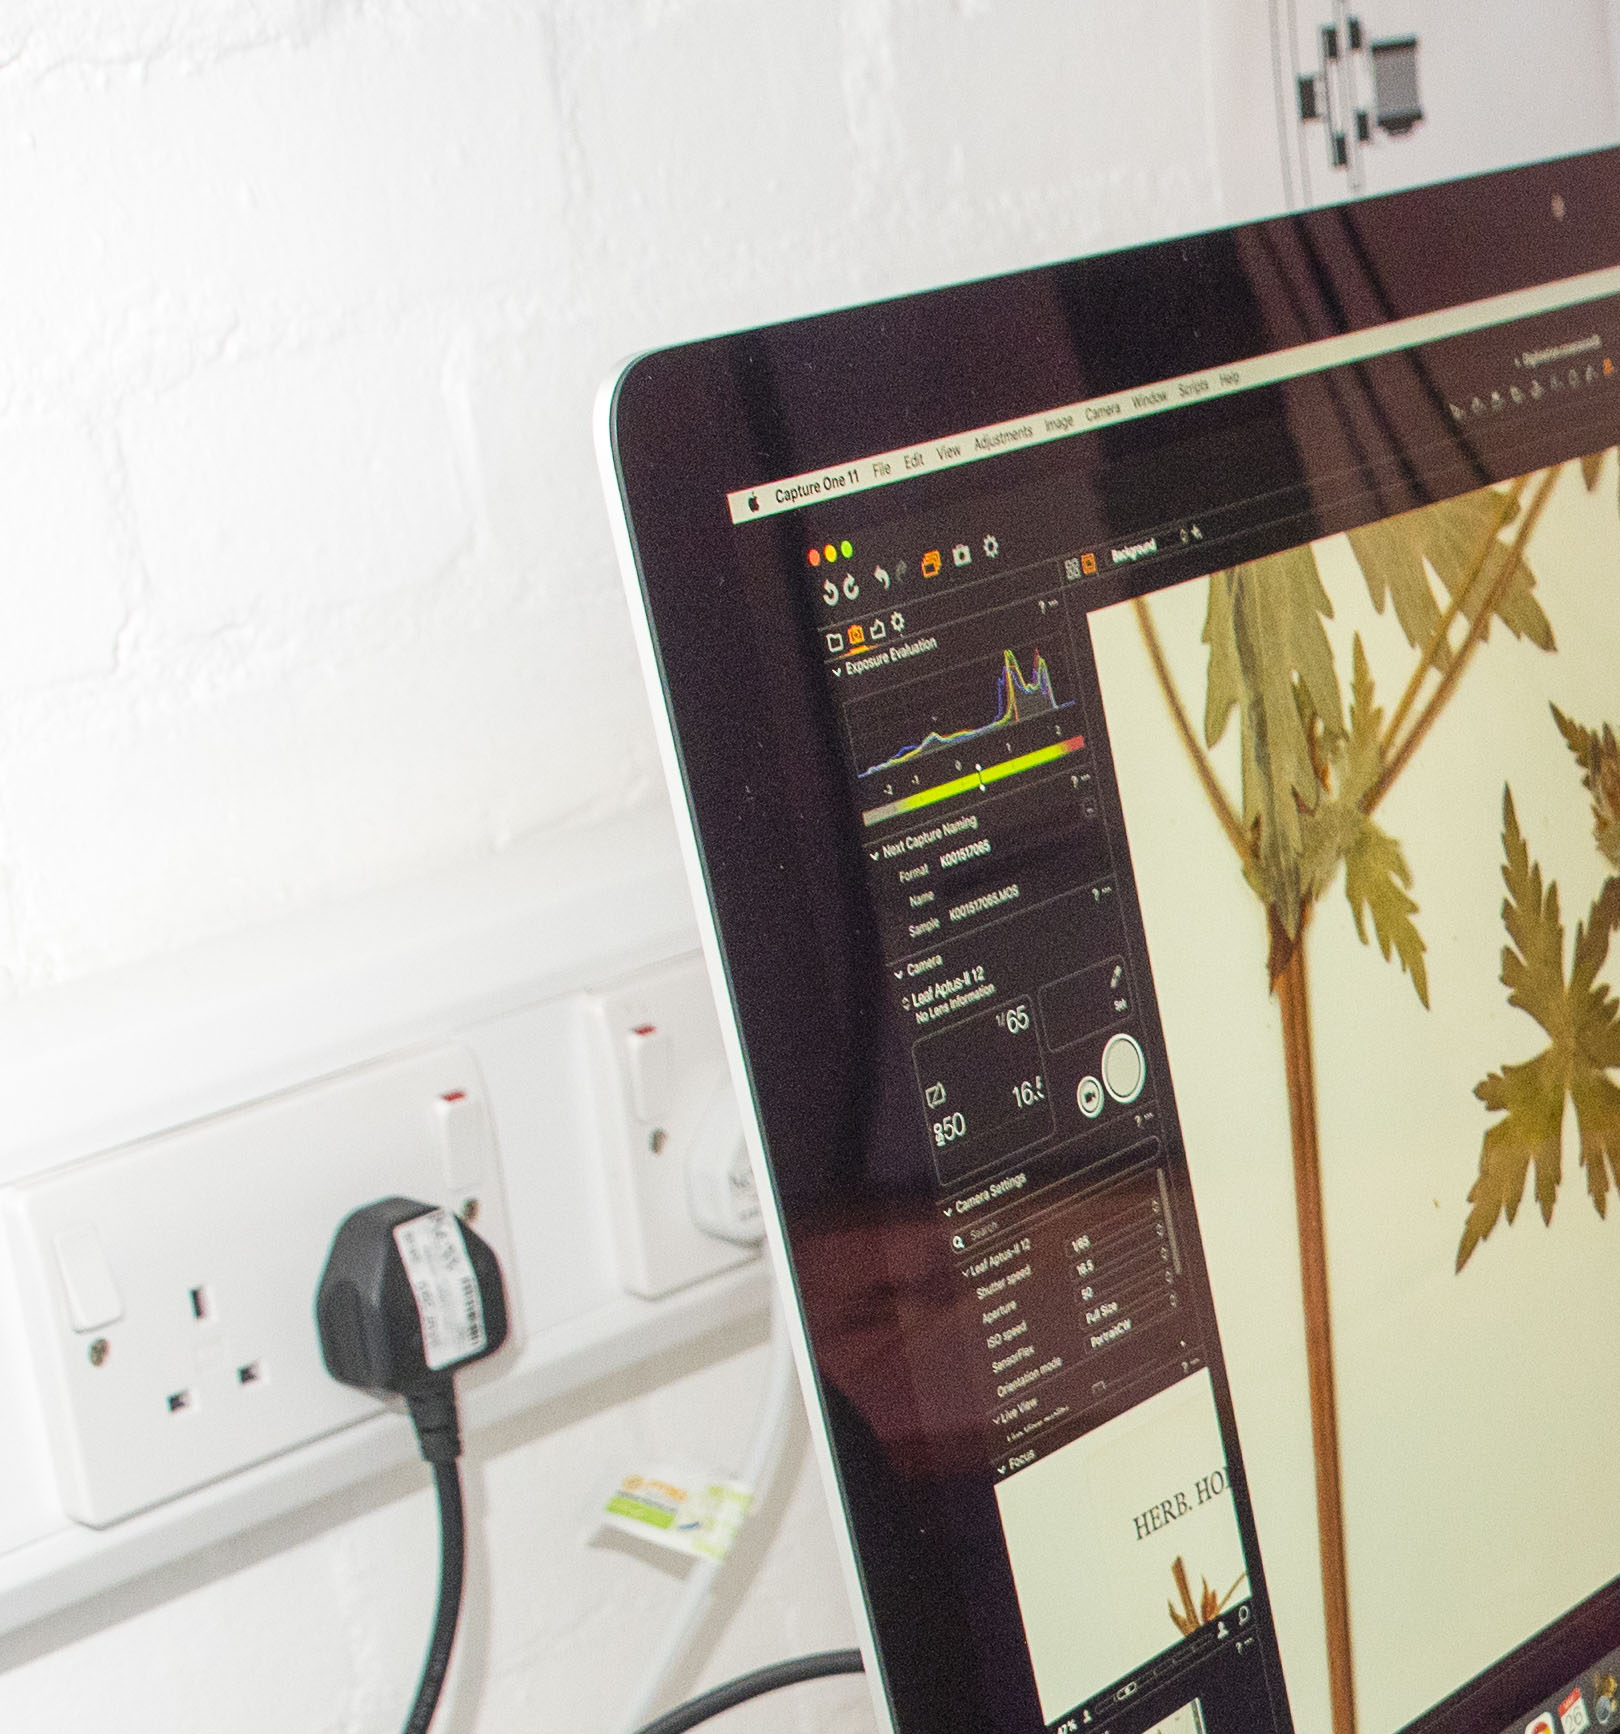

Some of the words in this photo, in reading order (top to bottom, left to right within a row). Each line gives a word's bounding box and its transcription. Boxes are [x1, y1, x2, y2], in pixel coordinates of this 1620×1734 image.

[774, 477, 821, 507] Capture
[821, 470, 847, 493] One
[847, 467, 860, 486] 11
[871, 459, 891, 479] File
[903, 450, 924, 471] Edit
[935, 440, 961, 462] View
[973, 422, 1034, 454] Adjustments
[1044, 412, 1075, 436] Image
[1084, 399, 1121, 424] Camera
[1131, 390, 1167, 409] Window
[1179, 378, 1209, 398] Scripts
[1219, 371, 1240, 387] Help
[844, 648, 889, 680] Exposure
[888, 633, 938, 664] Evaluation
[881, 837, 906, 860] Next
[906, 822, 946, 853] Capture
[945, 811, 978, 840] Naming
[898, 860, 930, 886] Format
[909, 888, 935, 909] Name
[908, 914, 940, 941] Sample
[906, 951, 943, 979] Camera
[911, 986, 934, 1008] Leaf
[971, 965, 985, 983] 12
[915, 1009, 928, 1024] No
[928, 1000, 949, 1019] Lens
[949, 981, 995, 1011] Information
[955, 1186, 990, 1215] Camera
[989, 1170, 1027, 1201] Settings
[969, 1257, 988, 1278] Leaf
[1020, 1236, 1031, 1253] 12
[976, 1274, 1006, 1301] Shutter
[1006, 1263, 1031, 1288] speed
[981, 1297, 1017, 1328] Aperture
[1086, 1307, 1101, 1325] Full
[1100, 1298, 1118, 1318] Size
[986, 1331, 1002, 1350] ISO
[1002, 1318, 1028, 1343] speed
[996, 1365, 1039, 1399] Orientation
[1039, 1354, 1062, 1376] mode
[1008, 1446, 1035, 1471] Focus
[1132, 1486, 1193, 1543] HERB.
